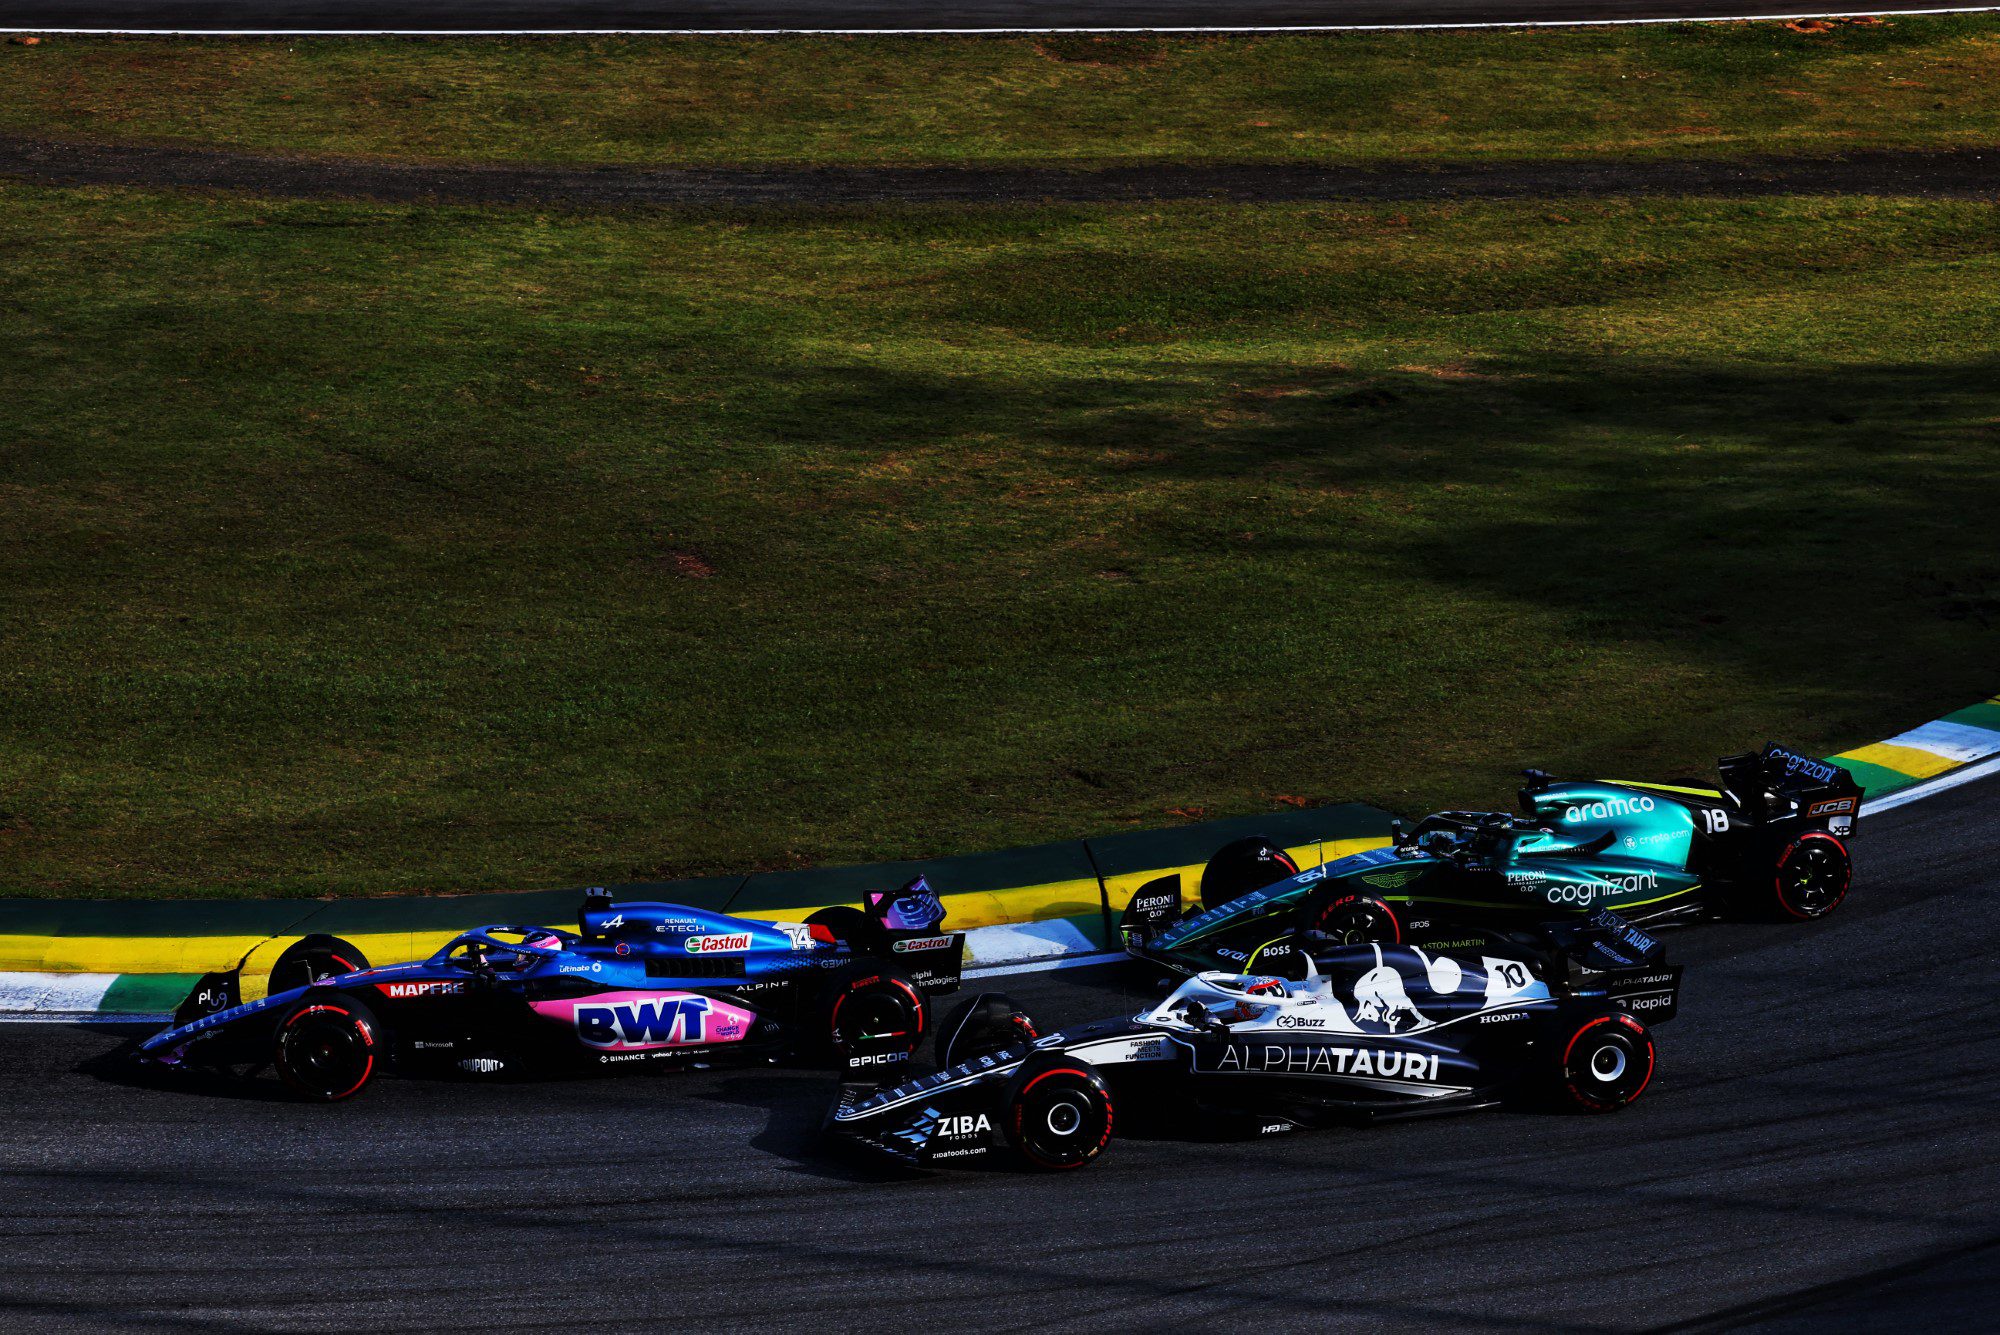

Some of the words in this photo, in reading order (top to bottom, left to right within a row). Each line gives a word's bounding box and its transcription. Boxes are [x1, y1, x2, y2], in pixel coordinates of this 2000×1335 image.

[1565, 796, 1655, 823] aramco
[1811, 800, 1852, 815] JCB
[1701, 808, 1730, 834] 18
[1638, 828, 1691, 846] crypto.com
[1507, 870, 1547, 883] PERONI
[1547, 869, 1659, 906] cognizant
[1136, 894, 1174, 909] PERONI
[655, 925, 706, 933] E-TECH
[1408, 920, 1431, 930] EPOS
[701, 935, 749, 951] Castrol
[784, 927, 814, 951] 14
[907, 937, 949, 951] Castrol
[1421, 942, 1450, 950] ASTON
[1452, 938, 1486, 949] MARTIN
[1263, 944, 1292, 957] BOSS
[909, 969, 933, 981] elphi
[1495, 963, 1527, 989] 10
[1612, 973, 1673, 986] ALPHATAURI
[389, 982, 465, 998] MAPFRE
[735, 980, 790, 992] ALPINE
[198, 988, 228, 1013] plug
[1632, 994, 1672, 1010] Rapid
[577, 997, 709, 1044] BWT
[1480, 1012, 1531, 1024] HONDA
[424, 1041, 454, 1049] Microsoft
[1130, 1039, 1161, 1048] FASHION
[609, 1053, 646, 1062] BINANCE
[1125, 1051, 1161, 1061] FUNCTION
[1216, 1044, 1440, 1082] ALPHATAURI
[462, 1058, 500, 1073] DUPONT
[937, 1113, 992, 1137] ZIBA
[949, 1132, 979, 1141] FOODS
[932, 1146, 987, 1159] zibafoods.com
